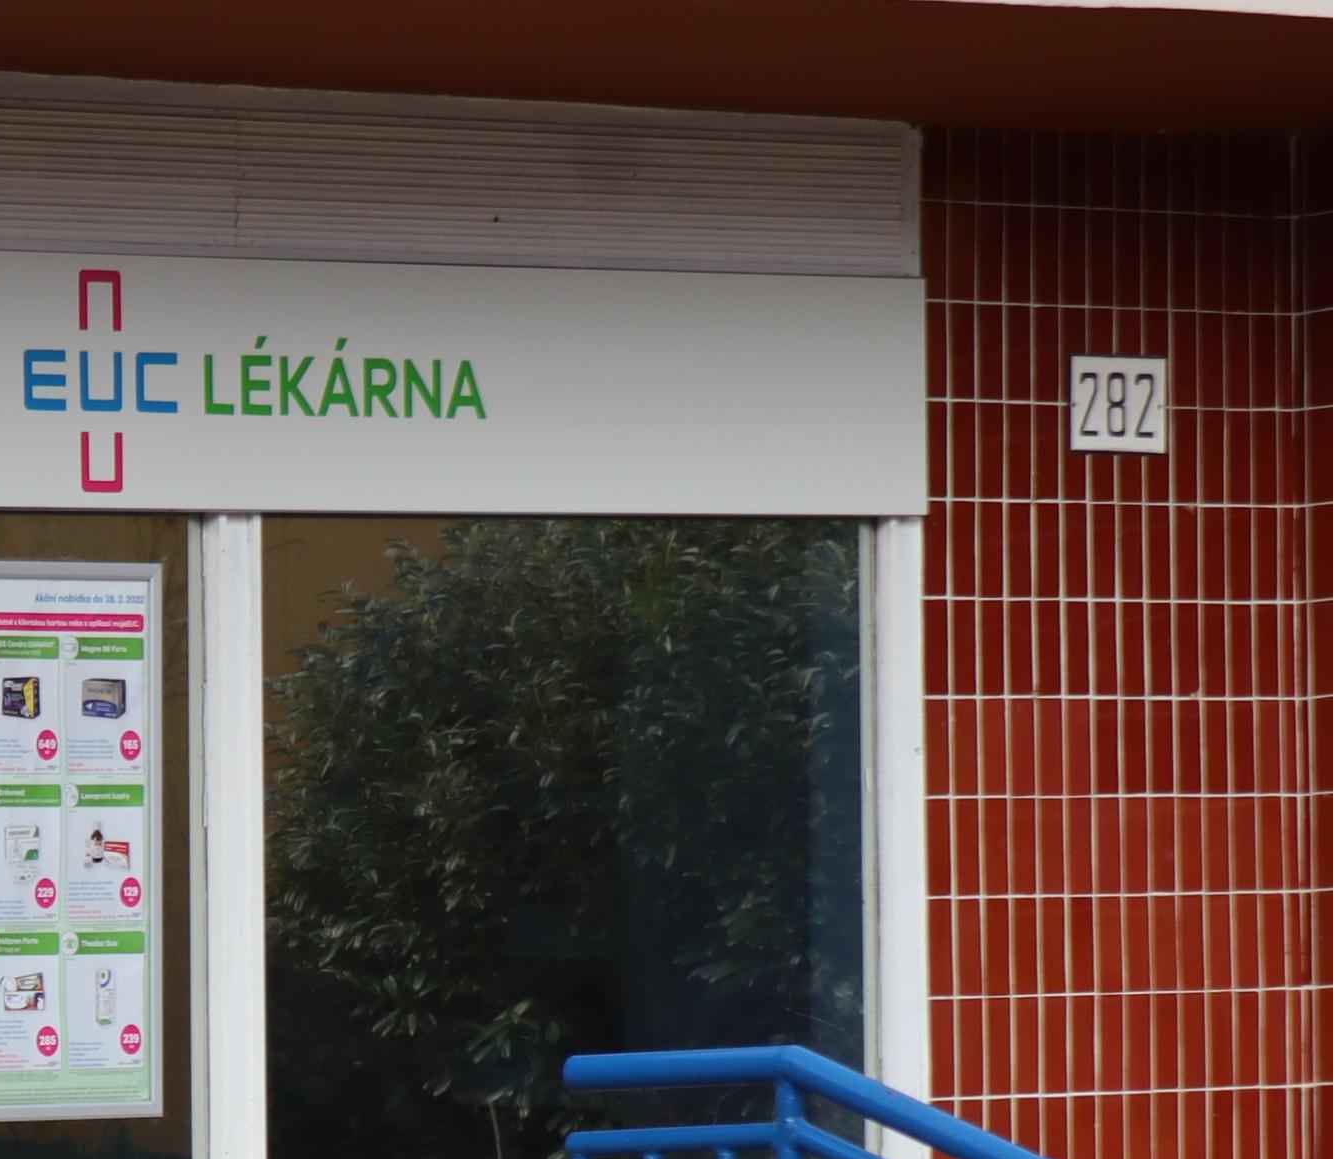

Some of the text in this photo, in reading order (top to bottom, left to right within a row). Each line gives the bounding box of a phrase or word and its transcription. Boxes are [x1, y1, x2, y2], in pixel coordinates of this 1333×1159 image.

[23, 335, 487, 419] EUC LÉKÁRNA
[1079, 372, 1155, 438] 282
[38, 739, 56, 750] 649
[123, 740, 138, 750] 165
[37, 887, 54, 898] 229
[123, 886, 139, 897] 129
[39, 1035, 56, 1046] 285
[123, 1034, 139, 1044] 239
